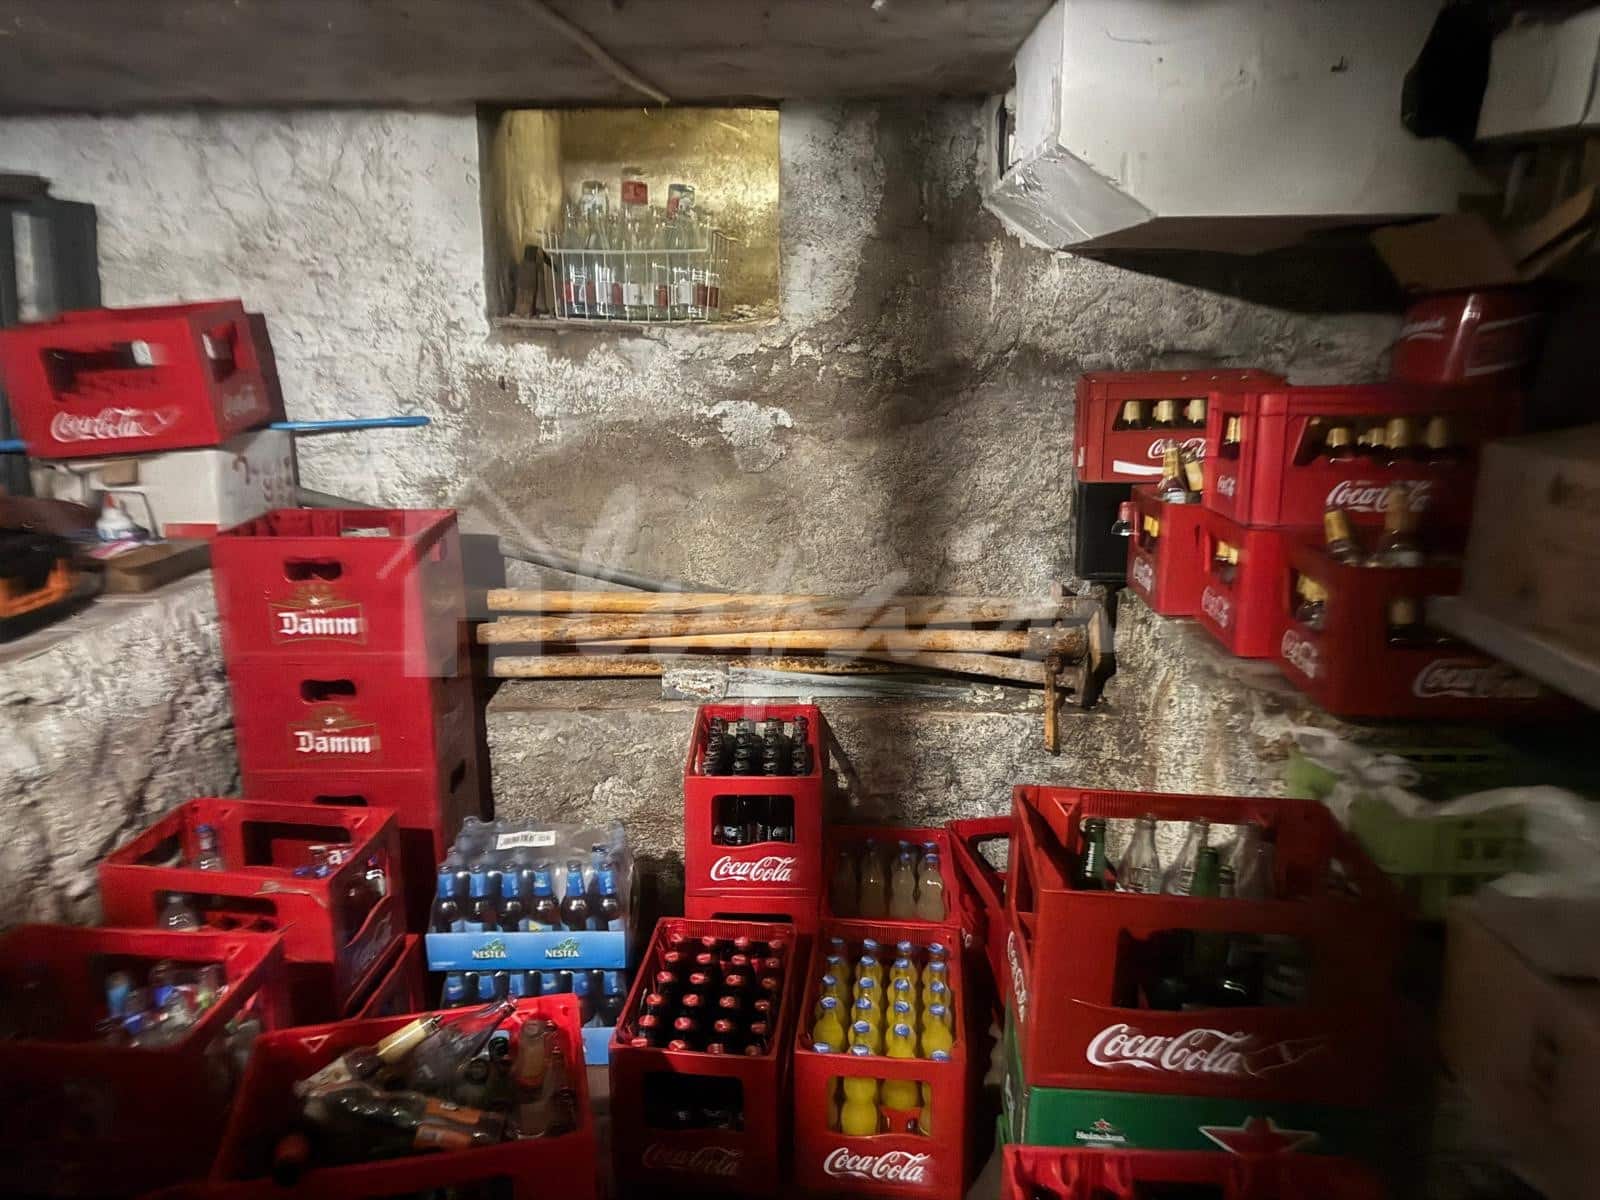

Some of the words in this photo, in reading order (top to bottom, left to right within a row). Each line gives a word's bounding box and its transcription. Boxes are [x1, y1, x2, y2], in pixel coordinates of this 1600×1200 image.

[277, 611, 359, 635] Damm
[293, 730, 372, 753] Damm
[710, 855, 797, 882] Coca-Cola
[1086, 1023, 1252, 1074] Coca-Cola
[823, 1147, 931, 1183] Coca-Cola
